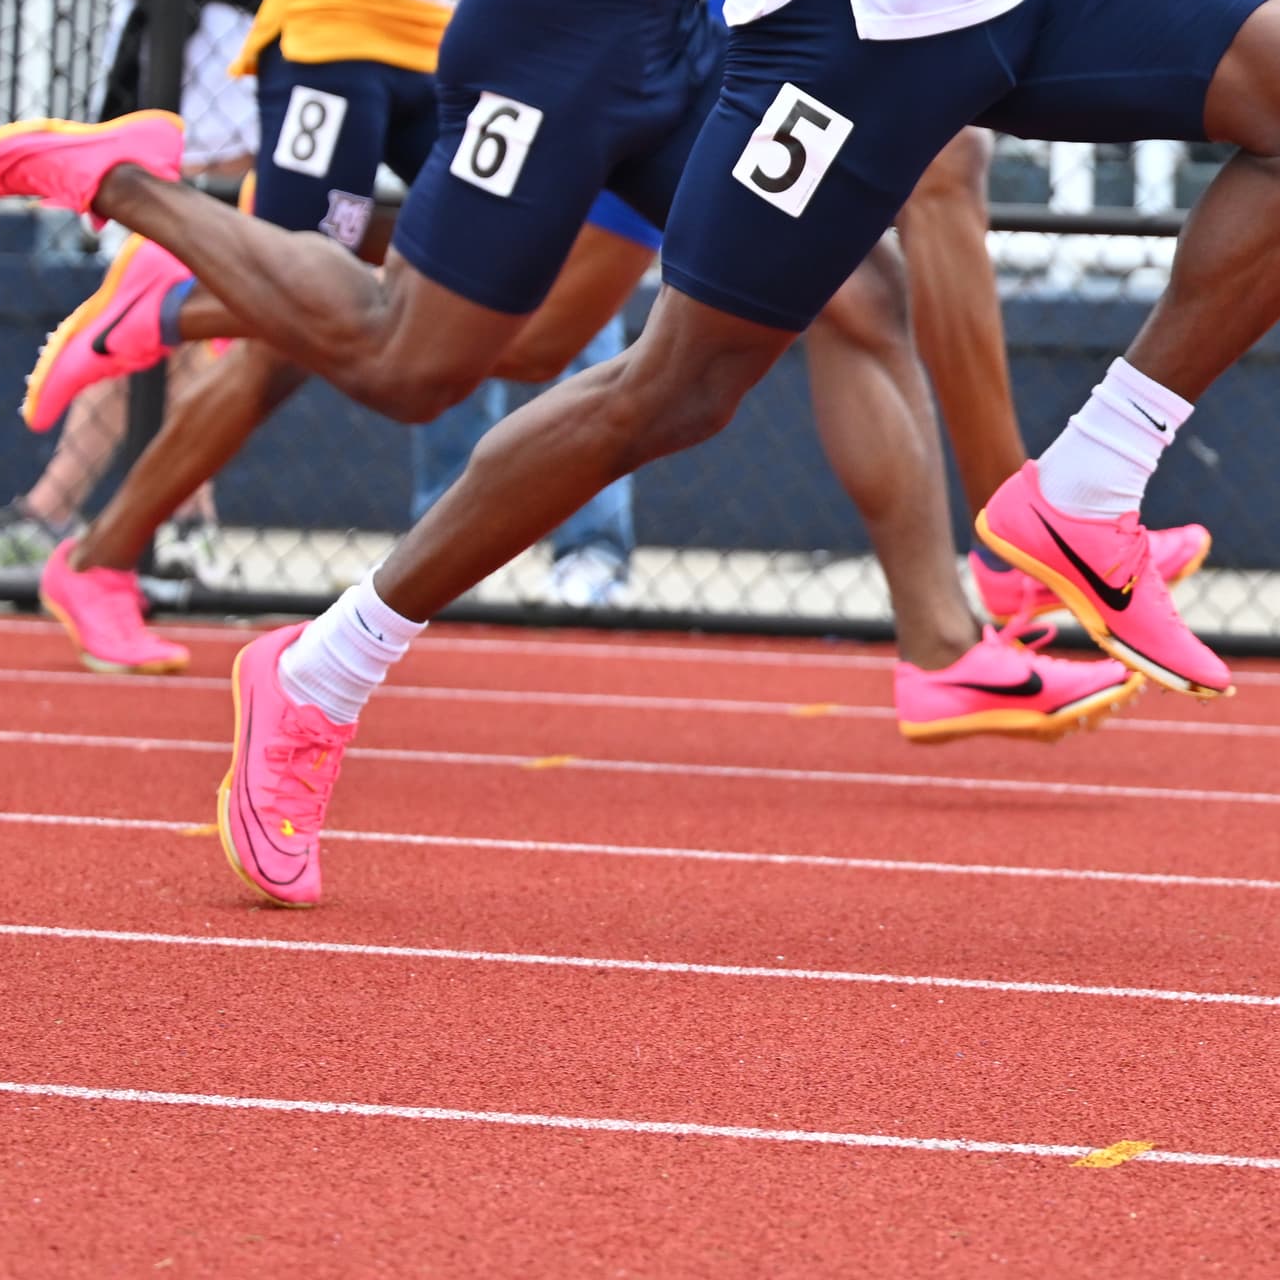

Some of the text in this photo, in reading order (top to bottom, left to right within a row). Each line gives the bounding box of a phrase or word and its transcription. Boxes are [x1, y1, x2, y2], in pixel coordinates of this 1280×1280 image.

[291, 100, 326, 161] 8
[471, 106, 519, 178] 6
[750, 99, 832, 193] 5
